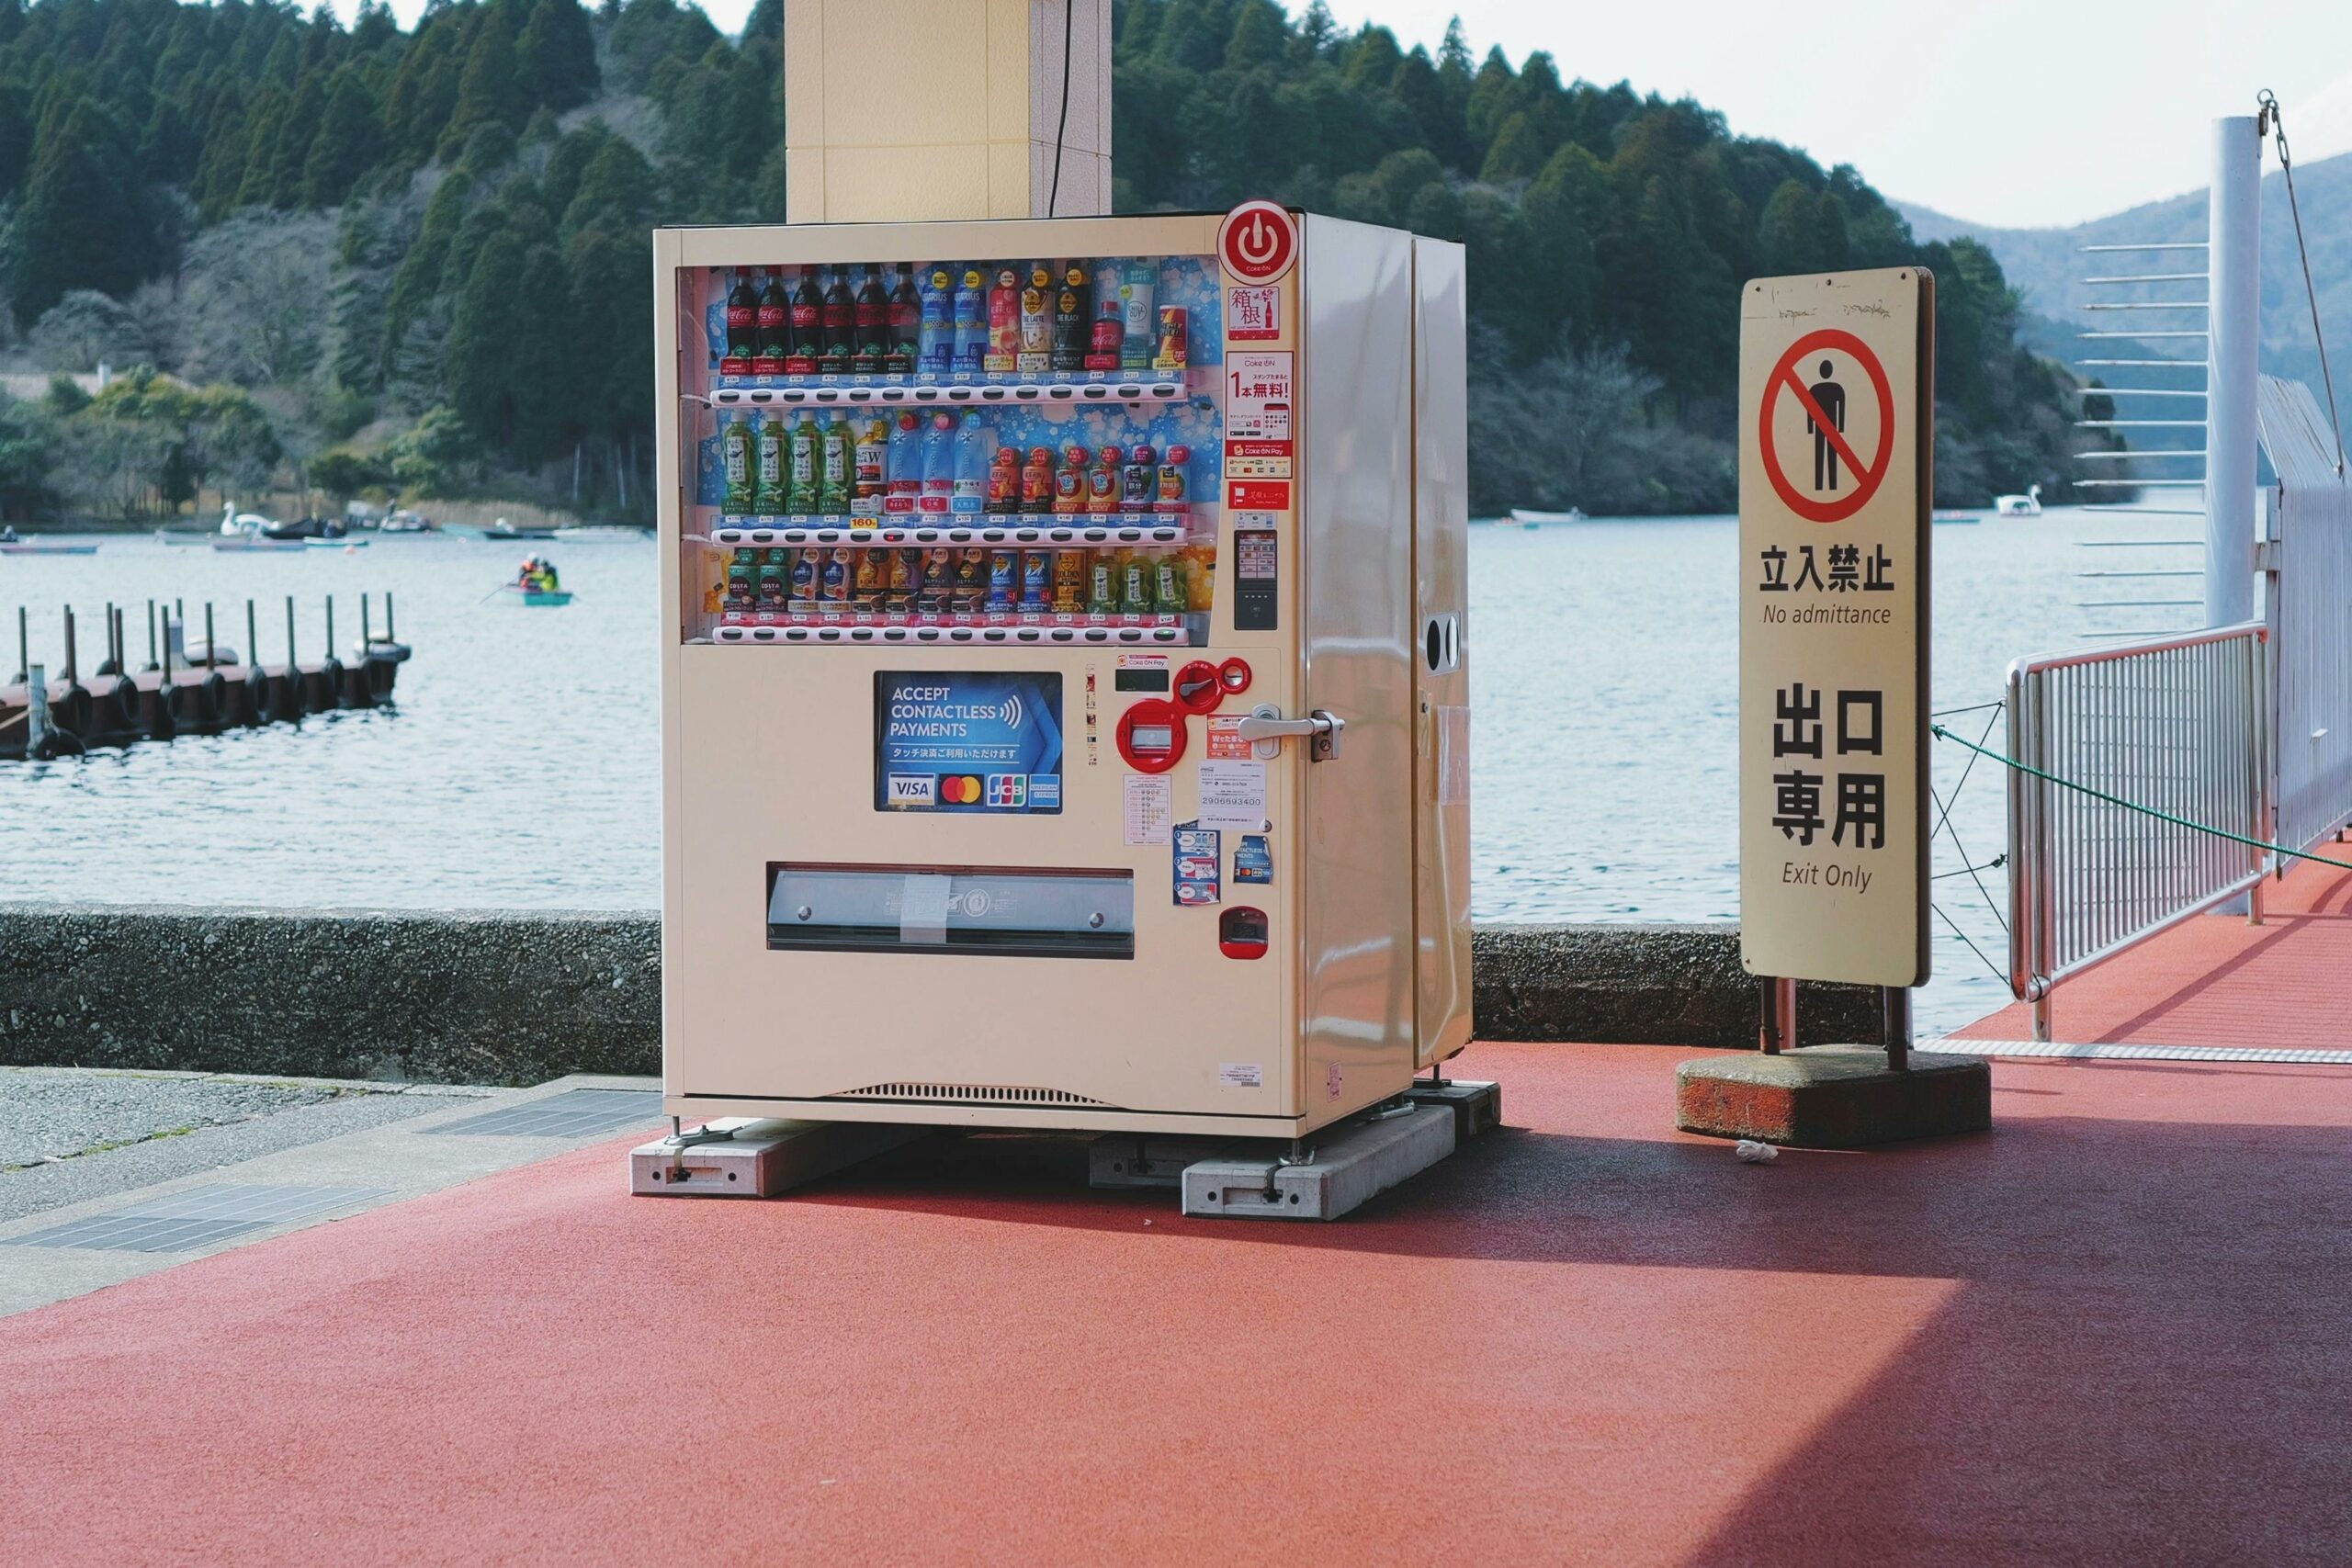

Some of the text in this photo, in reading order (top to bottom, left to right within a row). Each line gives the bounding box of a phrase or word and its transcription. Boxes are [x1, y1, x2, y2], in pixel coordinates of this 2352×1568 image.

[1231, 289, 1261, 324] 箱根
[868, 451, 881, 463] W
[1759, 544, 1894, 592] 立入禁止
[1763, 603, 1891, 624] No admittance
[892, 687, 950, 701] ACCEPT
[891, 705, 996, 719] CONTACTLESS
[1773, 682, 1883, 759] 出口
[890, 723, 967, 737] PAYMENTS
[893, 749, 1016, 759] タッチ決済ご利用いただけます
[895, 782, 929, 795] VISA
[1772, 770, 1885, 850] 専用
[1782, 862, 1872, 894] Exit Only
